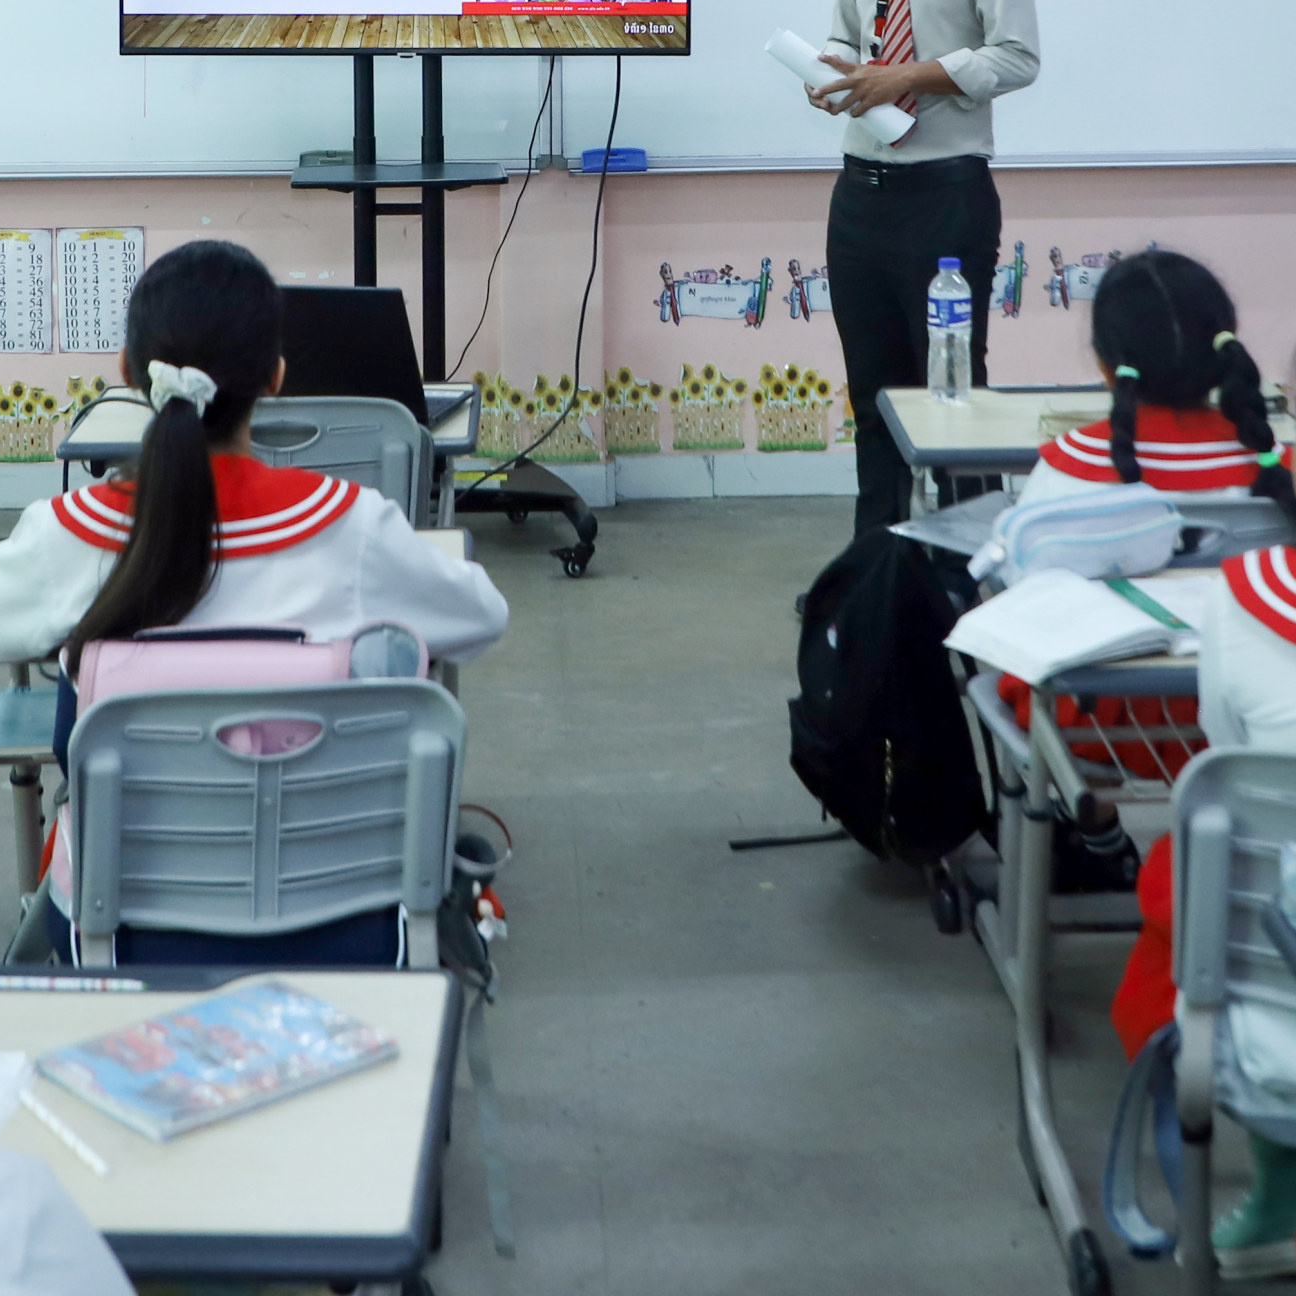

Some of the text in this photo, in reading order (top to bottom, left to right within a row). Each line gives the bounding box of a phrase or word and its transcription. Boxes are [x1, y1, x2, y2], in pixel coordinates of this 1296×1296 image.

[1, 243, 5, 253] 1
[28, 243, 36, 253] 9
[63, 242, 76, 252] 10
[93, 242, 97, 252] 1
[122, 242, 136, 252] 10
[0, 254, 6, 264] 2
[30, 254, 43, 264] 18
